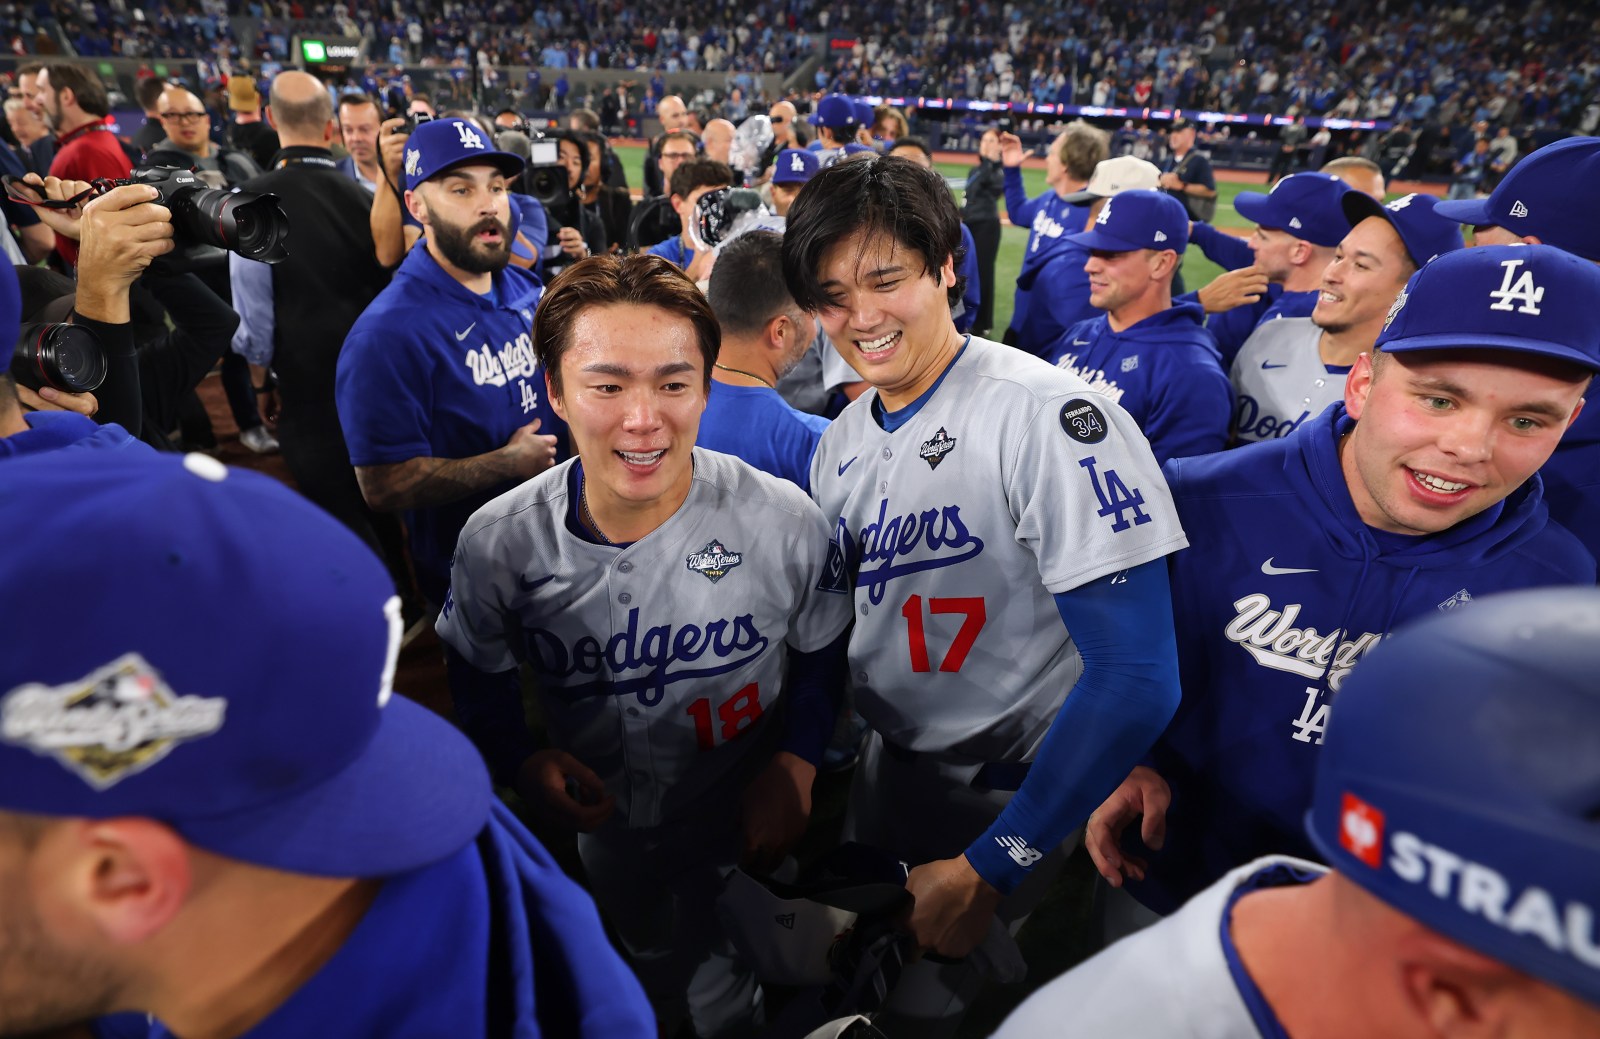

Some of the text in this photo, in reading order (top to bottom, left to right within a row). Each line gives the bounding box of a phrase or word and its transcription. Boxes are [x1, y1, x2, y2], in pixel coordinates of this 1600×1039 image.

[453, 121, 485, 149] LA
[1489, 259, 1545, 315] LA
[518, 379, 537, 414] LA
[1065, 405, 1093, 420] FERNANDO
[1072, 412, 1103, 437] 34
[1078, 456, 1152, 533] LA
[522, 606, 768, 707] Dodgers
[902, 593, 987, 673] 17
[686, 681, 764, 752] 18
